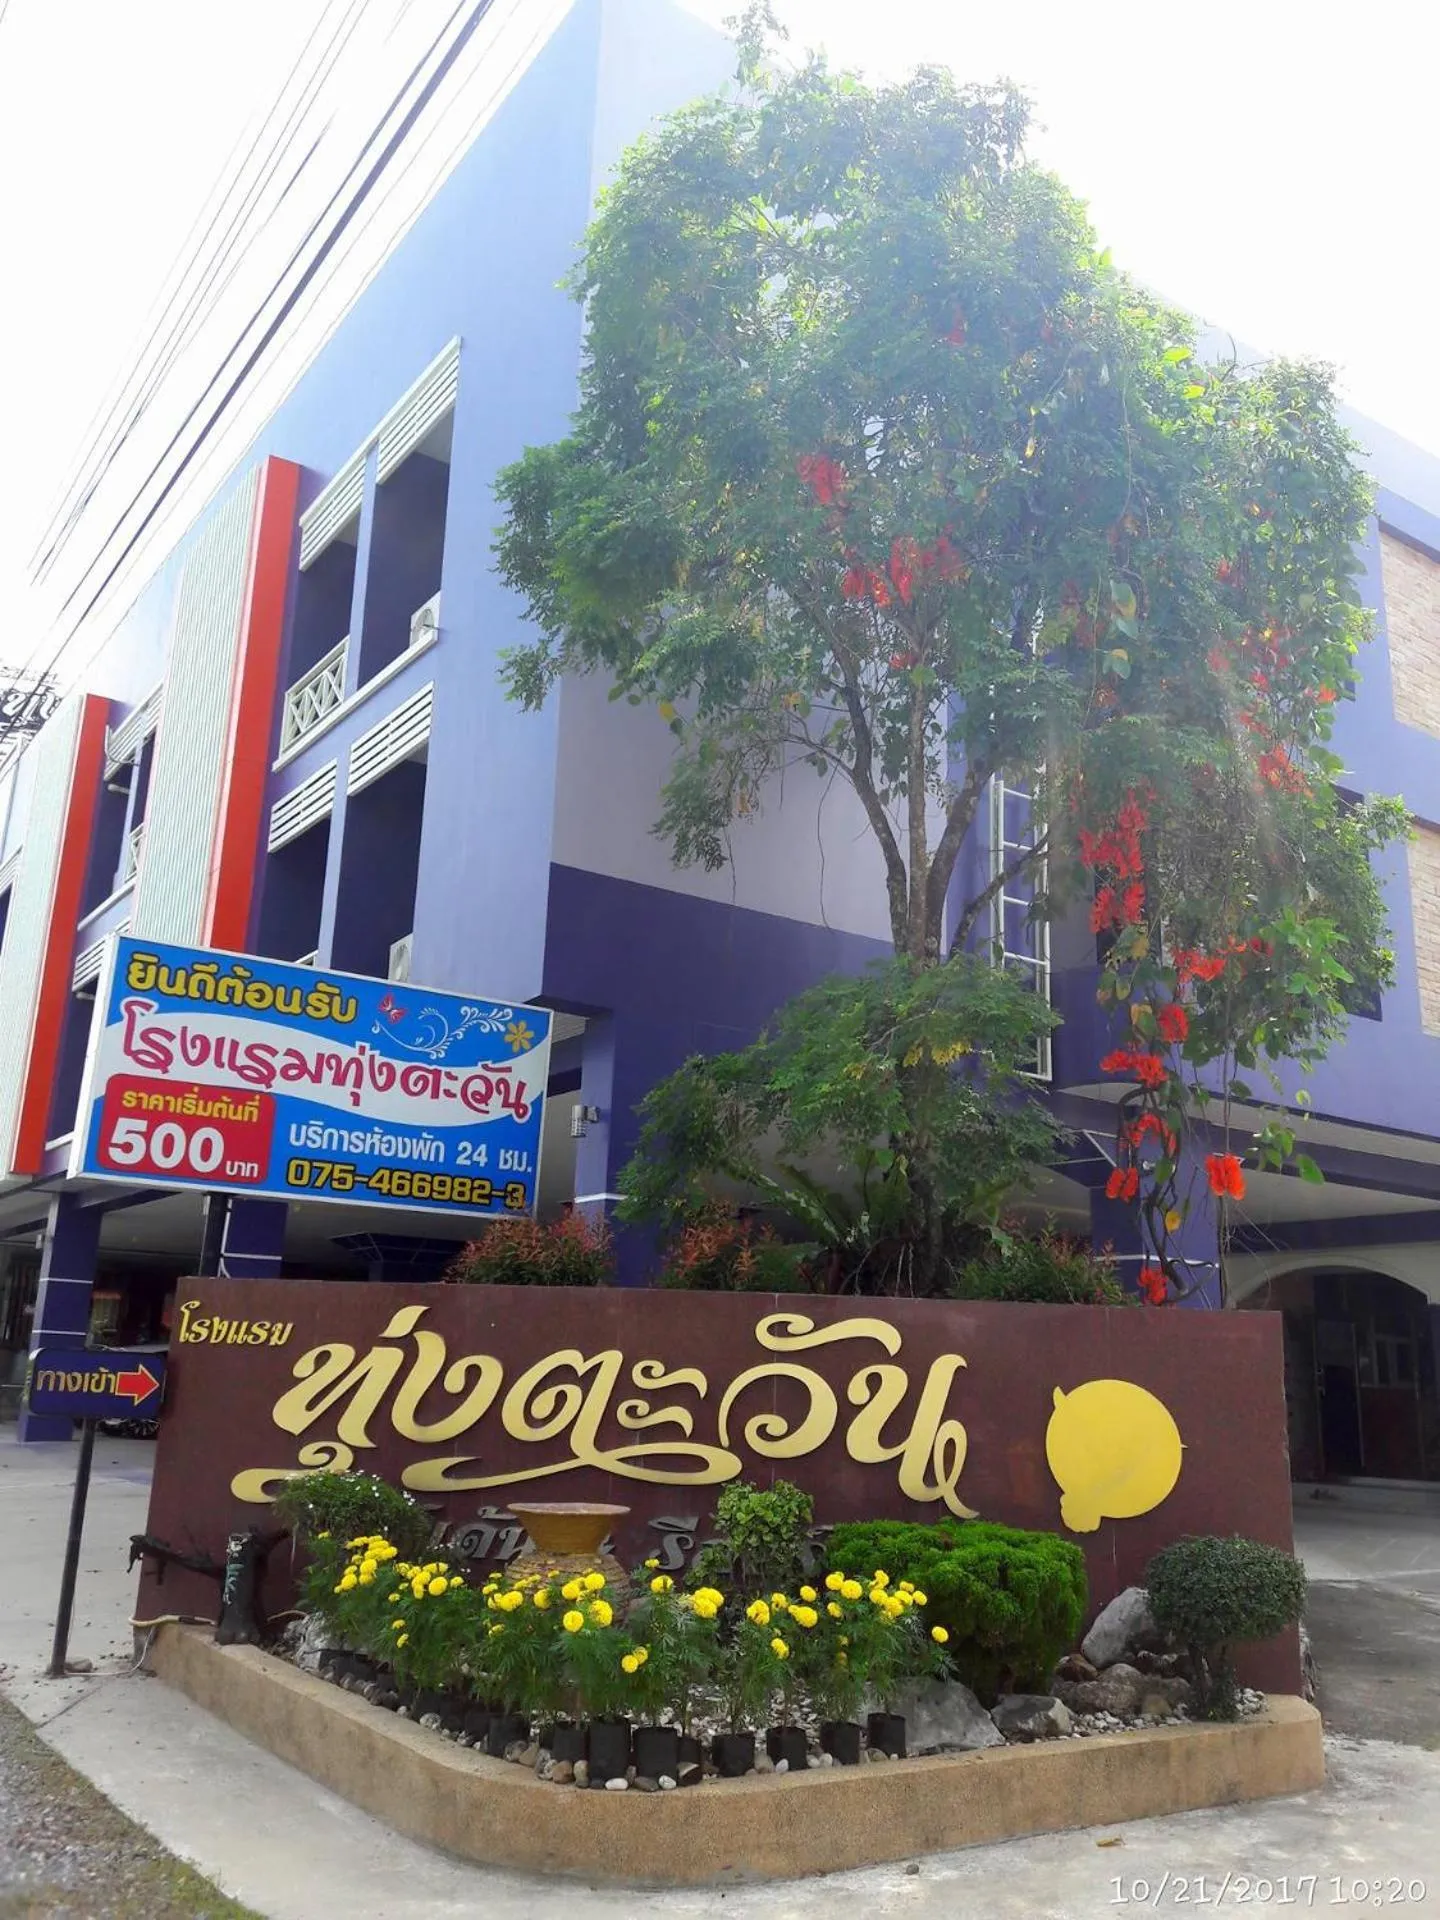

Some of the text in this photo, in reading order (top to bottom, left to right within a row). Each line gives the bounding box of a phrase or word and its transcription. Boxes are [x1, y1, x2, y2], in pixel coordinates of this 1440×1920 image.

[127, 953, 358, 1023] ยินดีต้อนรับ
[123, 999, 530, 1119] โรงแรมทุ่งตะวัน
[122, 1086, 260, 1122] ราคาเริ่มต้นที่
[108, 1116, 259, 1178] 500 บาท
[288, 1120, 534, 1173] บริการห้องพัก 24 ชม.
[287, 1158, 526, 1210] 075-466982-3
[178, 1299, 294, 1346] โรงแรม
[36, 1366, 117, 1393] ทางเข้า
[230, 1305, 980, 1519] ทุ่งตะวัน
